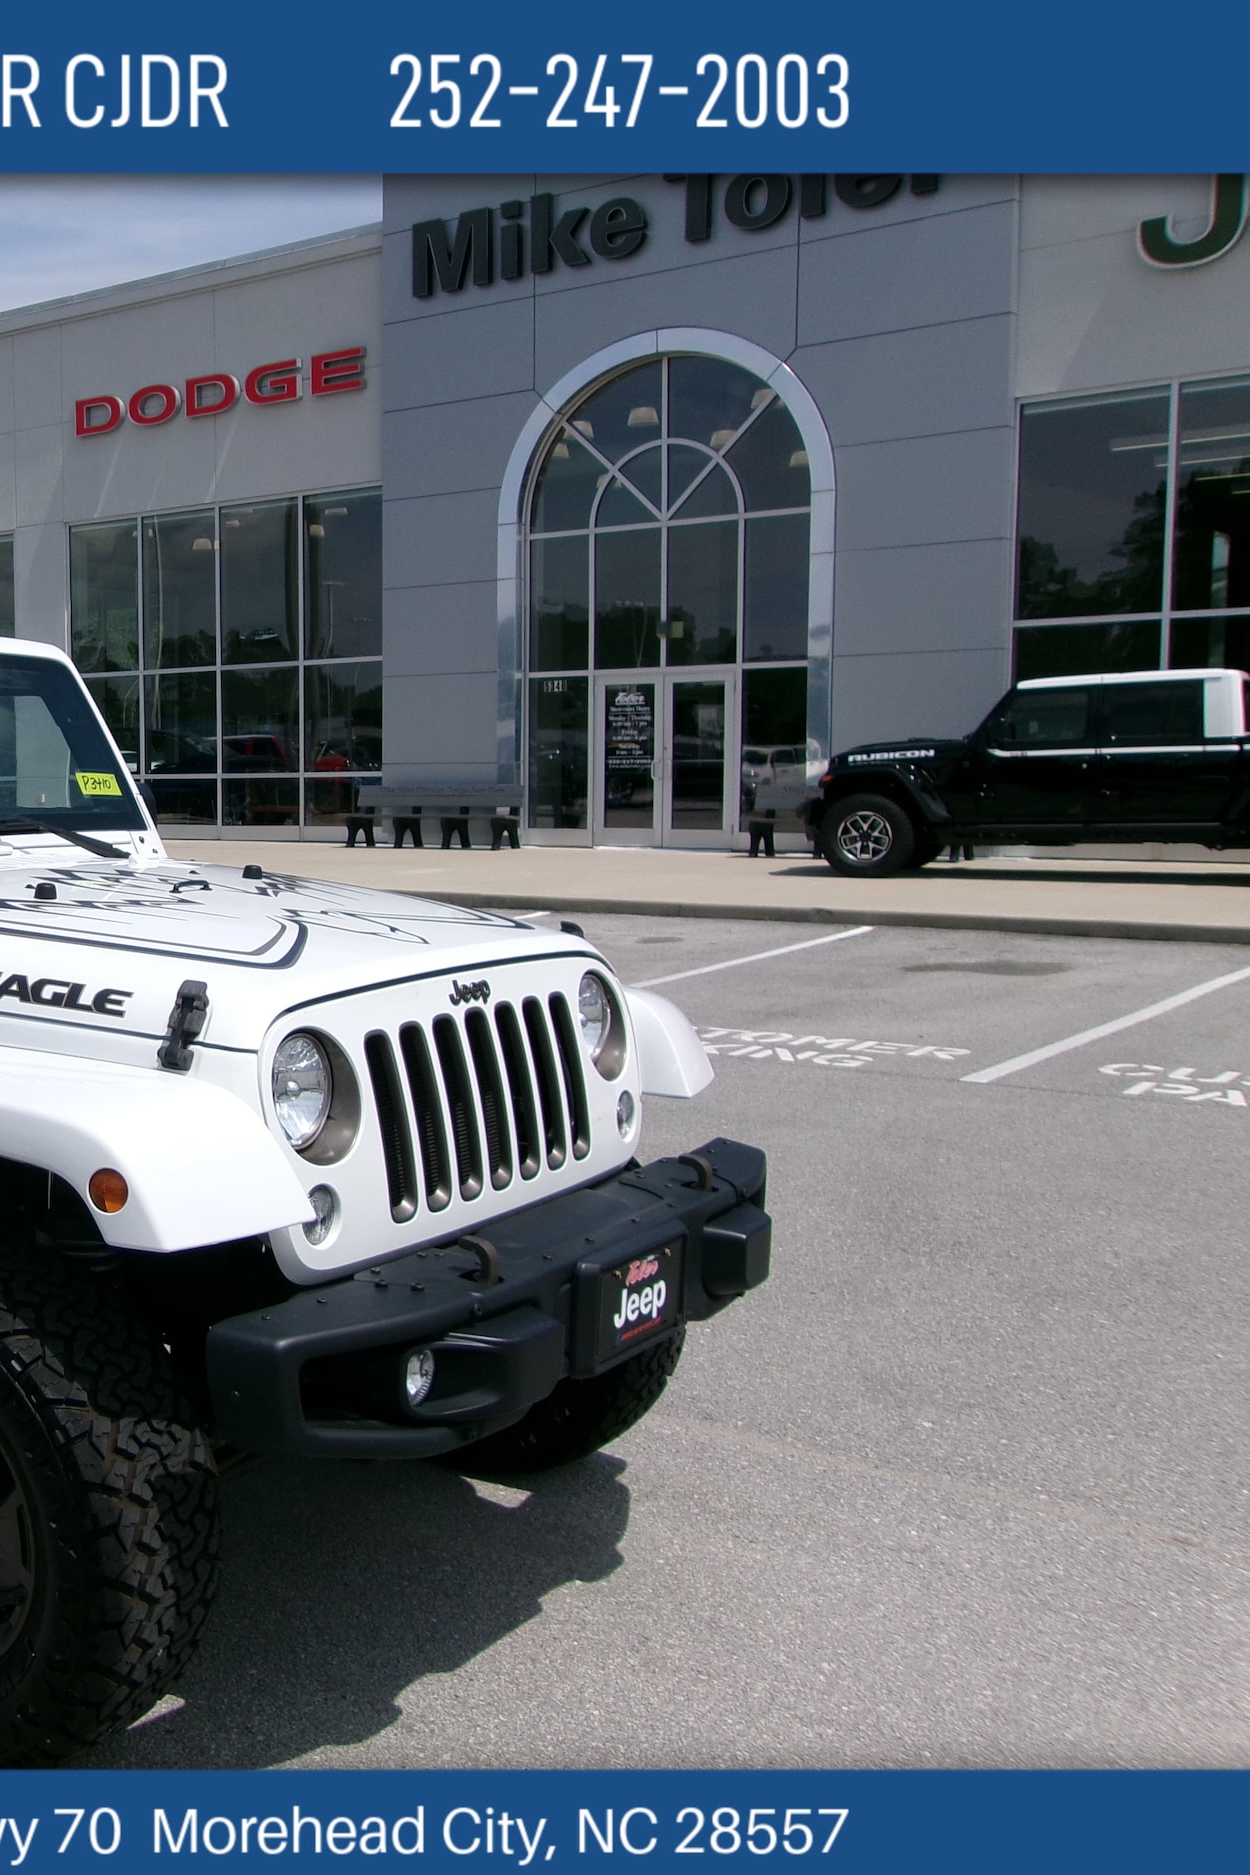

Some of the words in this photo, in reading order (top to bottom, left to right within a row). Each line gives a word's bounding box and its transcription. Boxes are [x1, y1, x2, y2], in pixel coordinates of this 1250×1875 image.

[411, 193, 650, 298] Mike
[74, 345, 368, 438] DODGE
[848, 749, 935, 762] RUBICON
[448, 979, 491, 1007] Jeep
[692, 1026, 972, 1060] TOMER
[613, 1280, 667, 1329] Jeep
